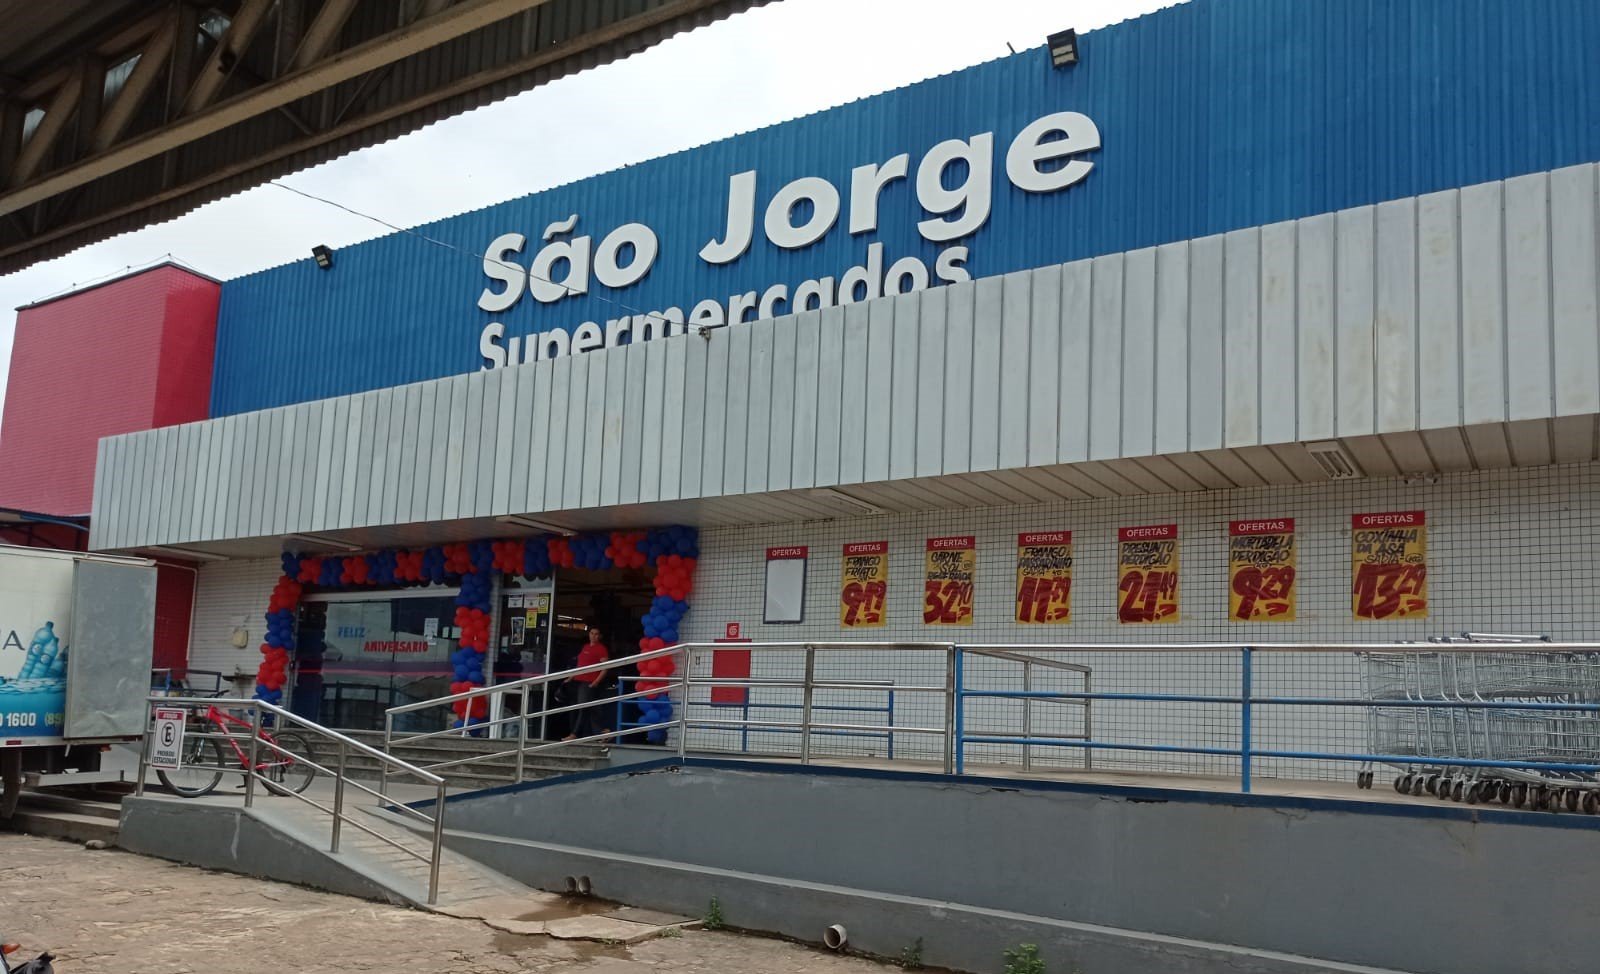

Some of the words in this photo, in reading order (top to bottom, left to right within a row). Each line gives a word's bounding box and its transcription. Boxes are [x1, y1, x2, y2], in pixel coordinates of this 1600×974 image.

[477, 214, 659, 313] São
[699, 111, 1102, 262] Jorge
[1362, 514, 1414, 525] OFERTAS
[1126, 527, 1169, 537] OFERTAS
[1238, 521, 1285, 532] OFERTAS
[933, 538, 968, 547] OFERTAS
[1025, 534, 1064, 543] OFERTAS
[772, 549, 801, 557] OFERTAS
[849, 544, 881, 552] OFERTAS
[337, 626, 366, 638] FELIZ
[0, 630, 25, 651] A
[7, 712, 36, 727] 1600
